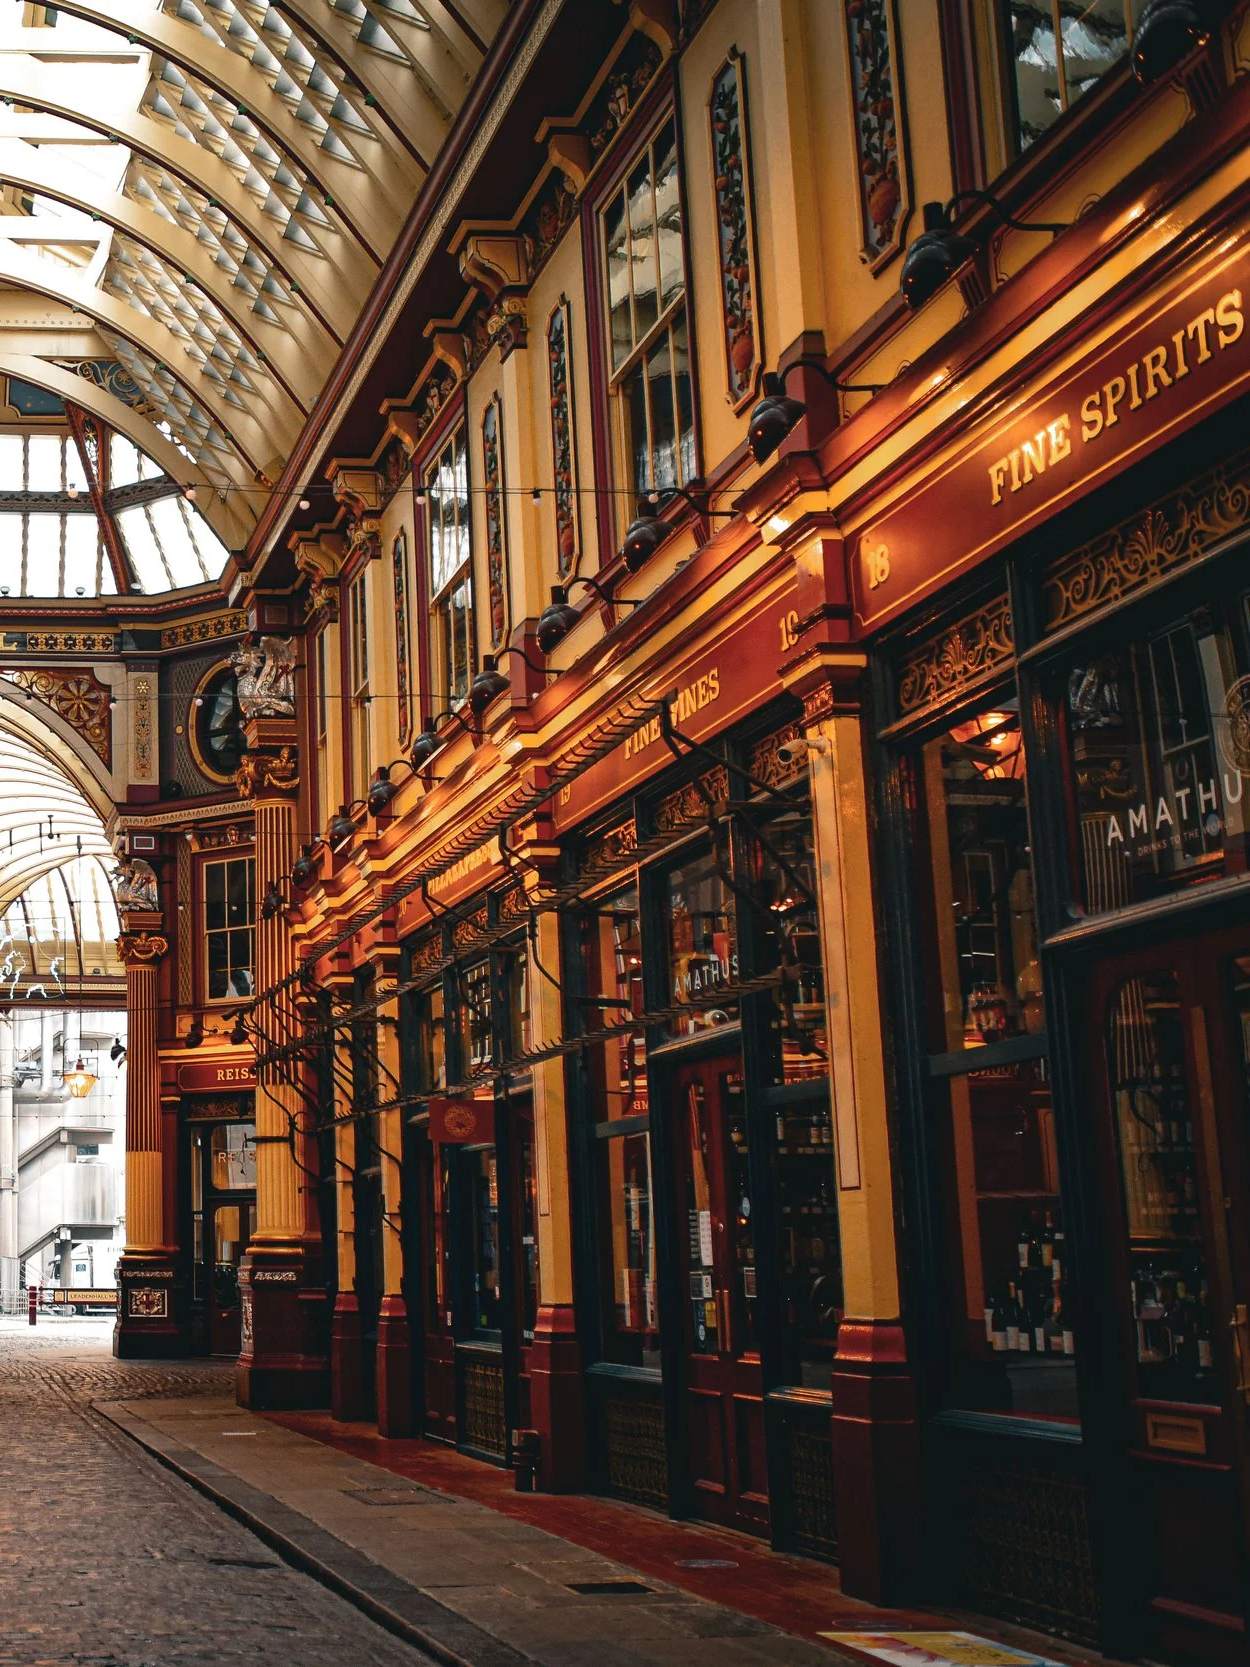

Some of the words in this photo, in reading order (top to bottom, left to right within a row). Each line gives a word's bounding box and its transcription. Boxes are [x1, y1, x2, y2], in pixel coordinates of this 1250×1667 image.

[988, 413, 1072, 507] FINE
[1081, 288, 1245, 444] SPIRITS
[867, 544, 891, 590] 18
[623, 714, 661, 760] FINE
[560, 783, 571, 807] 19
[1106, 769, 1245, 847] AMATHU
[1138, 840, 1168, 857] DRINKS
[1170, 835, 1181, 847] TO
[1183, 828, 1200, 841] THE
[674, 954, 739, 999] AMATHUS
